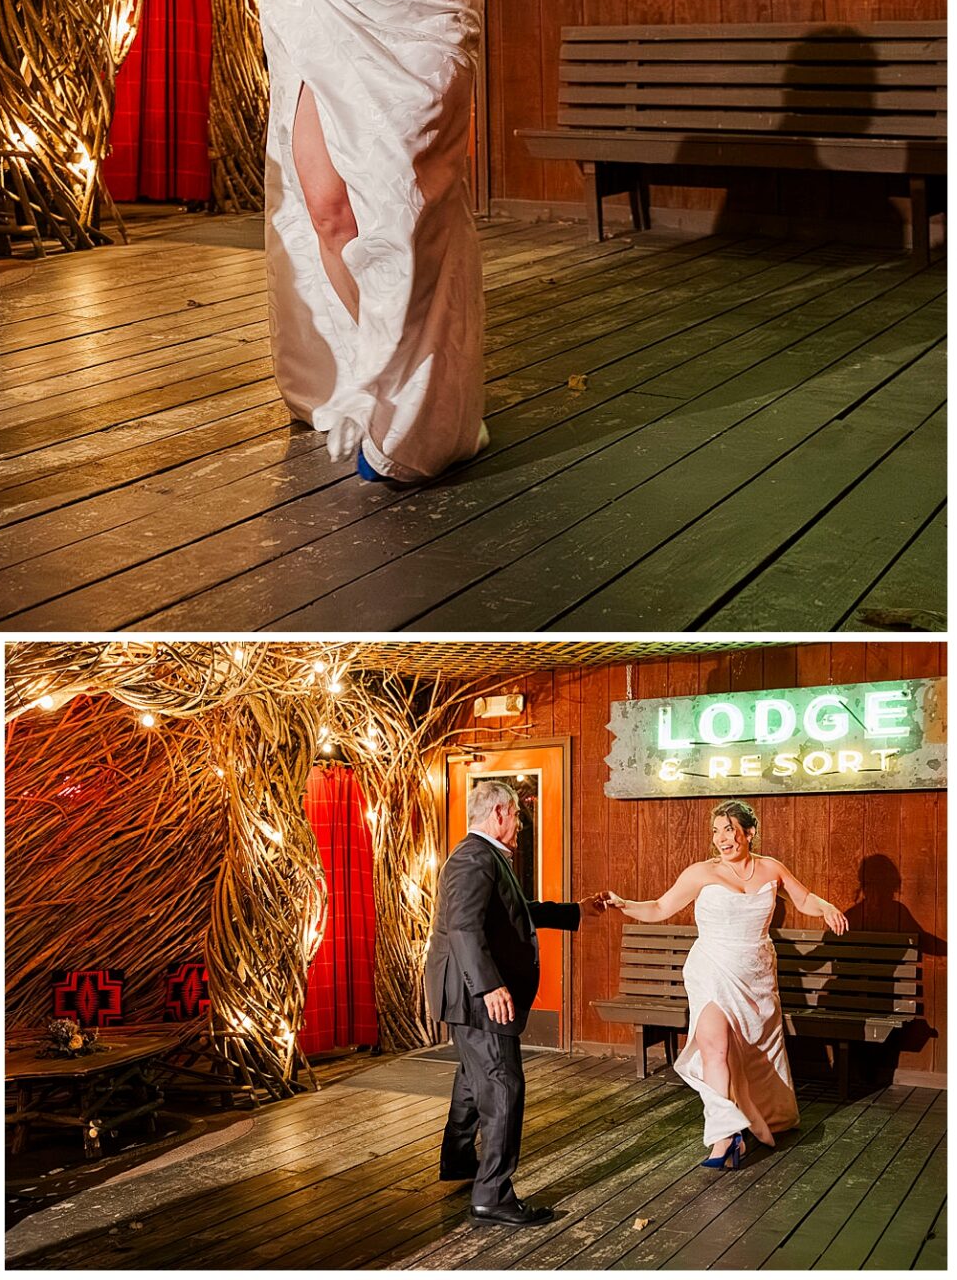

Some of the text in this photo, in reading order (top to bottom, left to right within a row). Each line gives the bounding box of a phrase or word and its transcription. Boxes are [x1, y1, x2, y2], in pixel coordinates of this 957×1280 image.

[657, 689, 911, 750] LODGE
[658, 747, 901, 781] & RESORT
